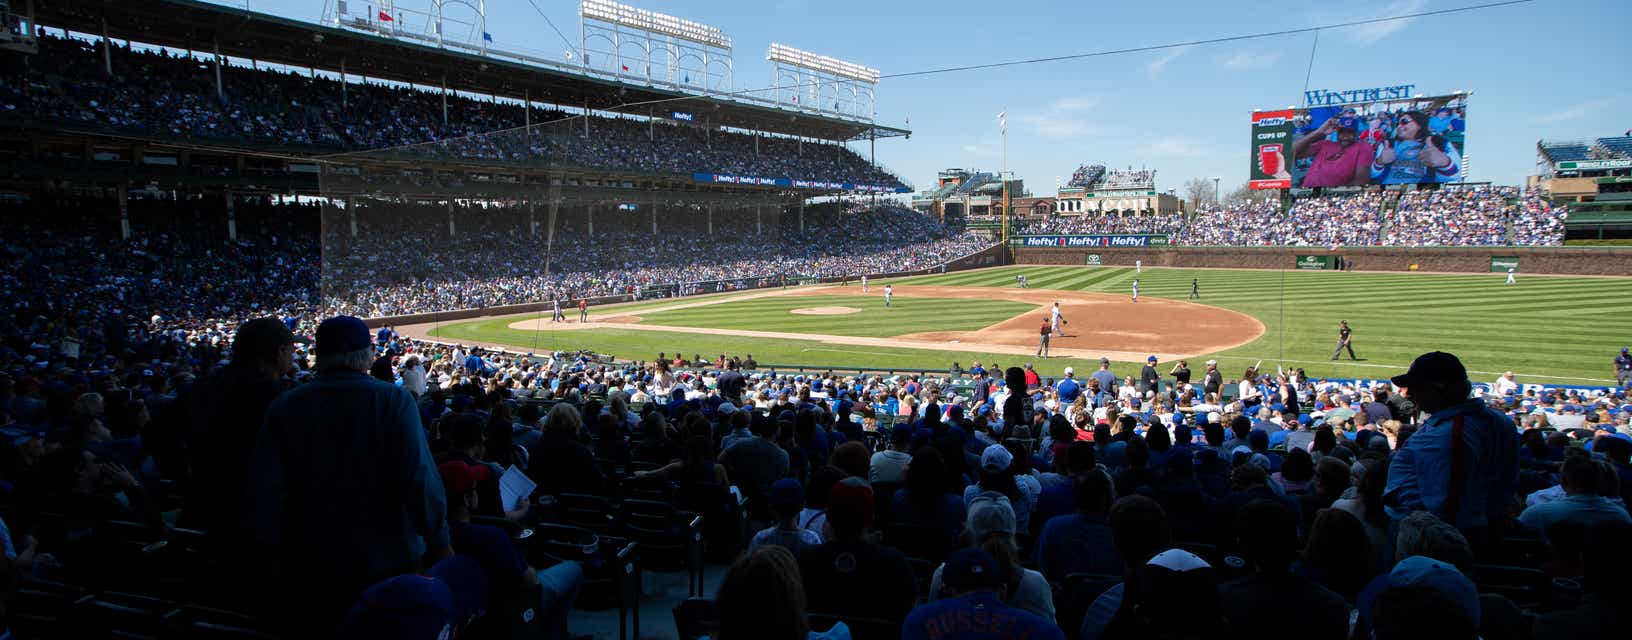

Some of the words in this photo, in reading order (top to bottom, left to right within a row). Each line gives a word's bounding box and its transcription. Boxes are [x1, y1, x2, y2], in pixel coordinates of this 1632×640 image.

[1304, 84, 1415, 105] WINTRUST
[1261, 118, 1285, 126] Hefty
[1257, 132, 1276, 140] CUPS
[1276, 131, 1287, 139] UP
[1028, 236, 1059, 247] Hefty!
[1068, 236, 1101, 247] Hefty!
[1111, 236, 1146, 247] Hefty!
